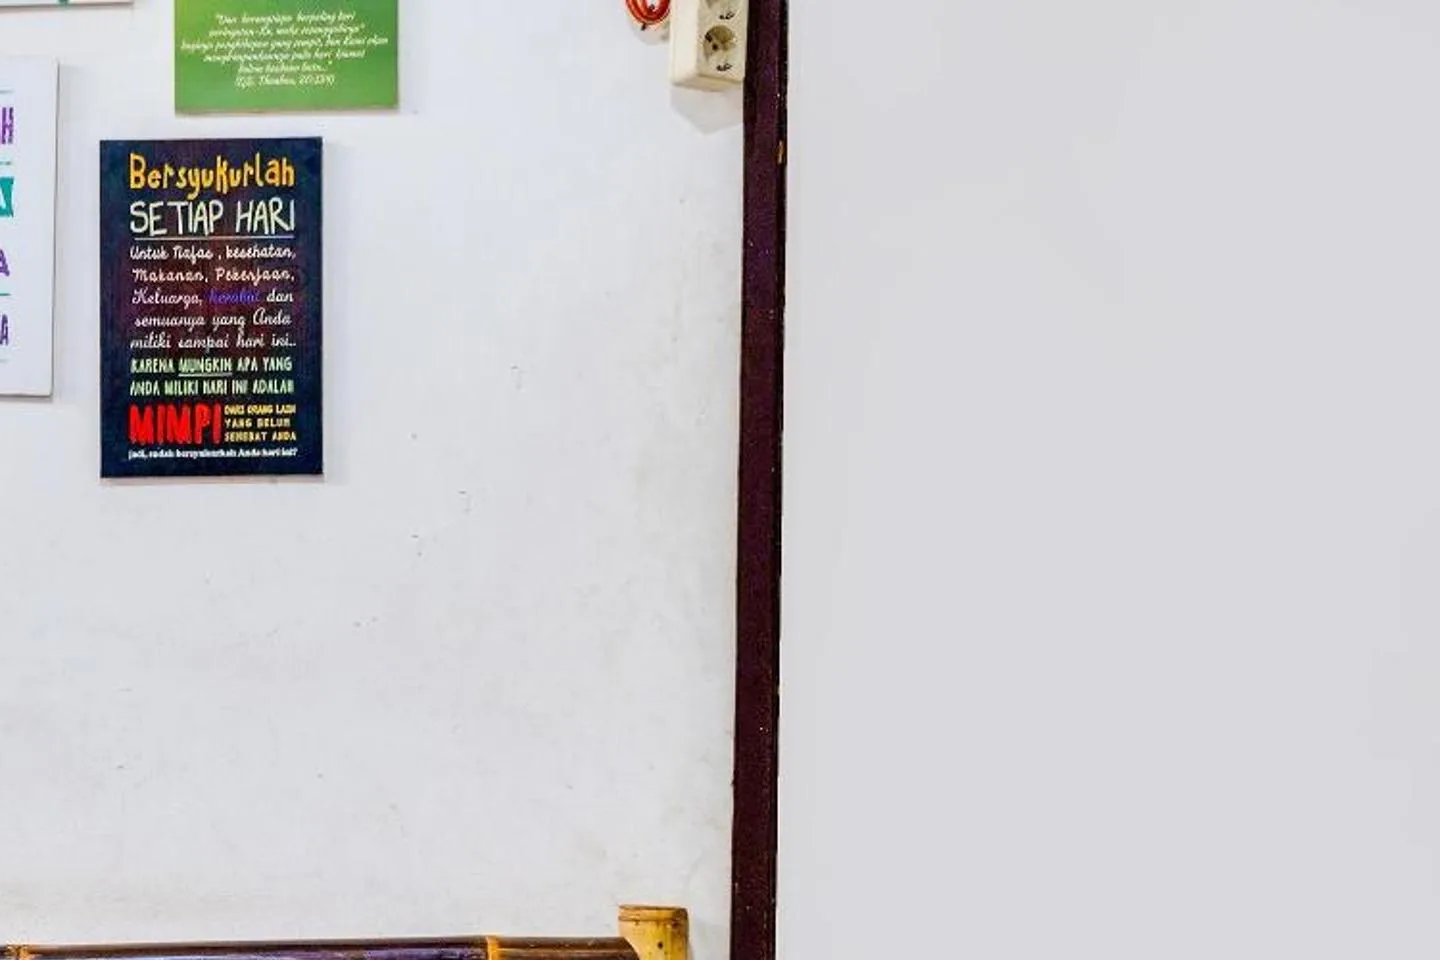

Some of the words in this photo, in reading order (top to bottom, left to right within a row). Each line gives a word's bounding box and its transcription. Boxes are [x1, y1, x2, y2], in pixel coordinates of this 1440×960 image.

[130, 200, 224, 236] SETIAP
[236, 197, 296, 235] HARI
[129, 246, 169, 261] Untuk
[266, 288, 294, 303] dan
[134, 315, 206, 333] semuanya
[212, 315, 246, 332] yang
[252, 307, 292, 325] Anda
[129, 332, 172, 349] miliki
[178, 332, 229, 352] sampai
[236, 331, 266, 348] hari
[130, 357, 175, 374] KARENA
[178, 356, 233, 373] MUNGKIN
[236, 356, 258, 372] APA
[262, 356, 293, 372] YANG
[130, 380, 160, 397] ANDA
[164, 379, 199, 397] MILIKI
[203, 379, 228, 395] HARI
[231, 379, 249, 395] INI
[252, 378, 295, 395] ADALAH
[128, 401, 224, 445] MIMPI
[224, 418, 253, 429] YANG
[256, 417, 291, 428] BELUM
[271, 431, 297, 441] ANDA
